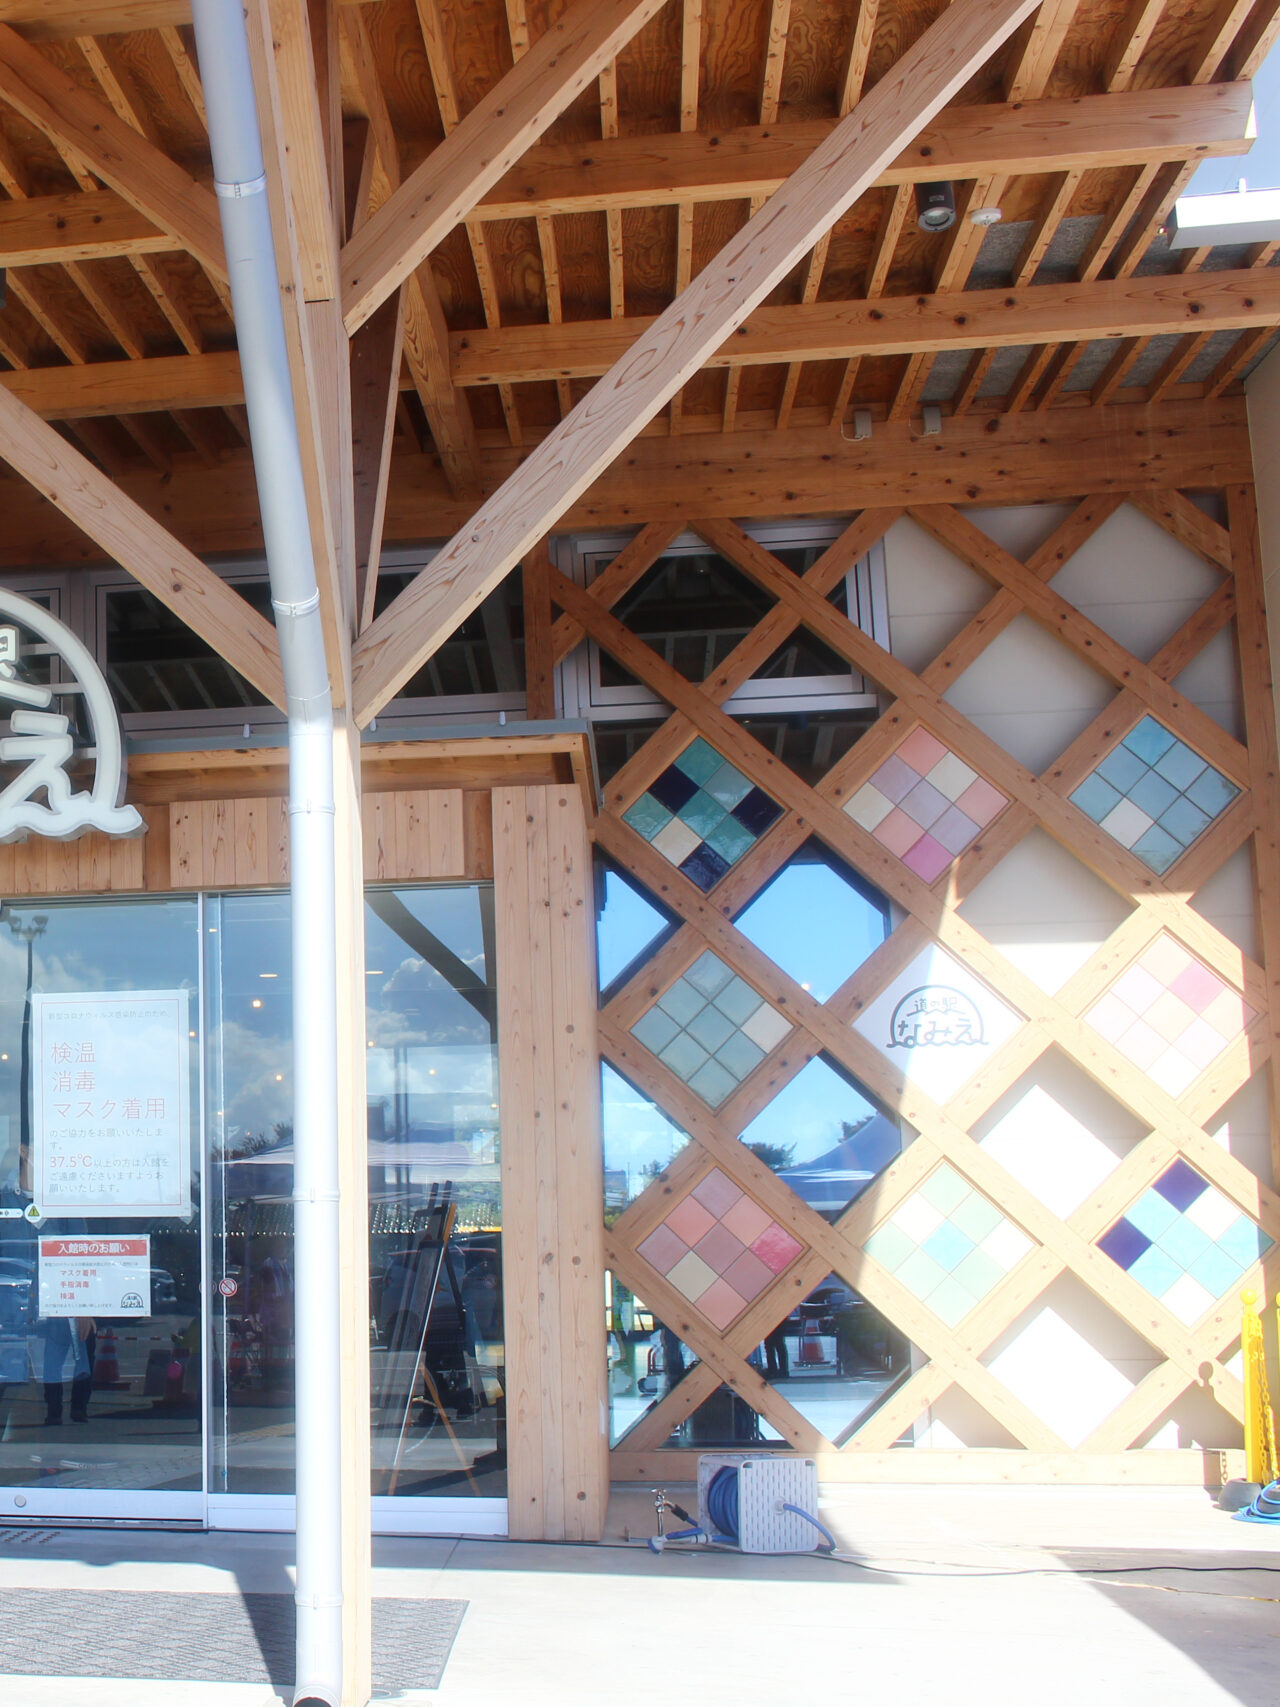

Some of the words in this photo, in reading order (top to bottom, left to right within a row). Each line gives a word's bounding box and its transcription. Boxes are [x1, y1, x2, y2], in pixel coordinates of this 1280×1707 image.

[913, 997, 958, 1014] 道の駅
[897, 1017, 974, 1048] なみえ
[51, 1041, 97, 1065] 検温
[51, 1069, 97, 1093] 消毒
[52, 1097, 166, 1121] マスク着用
[57, 1242, 131, 1255] 入館時のお願い
